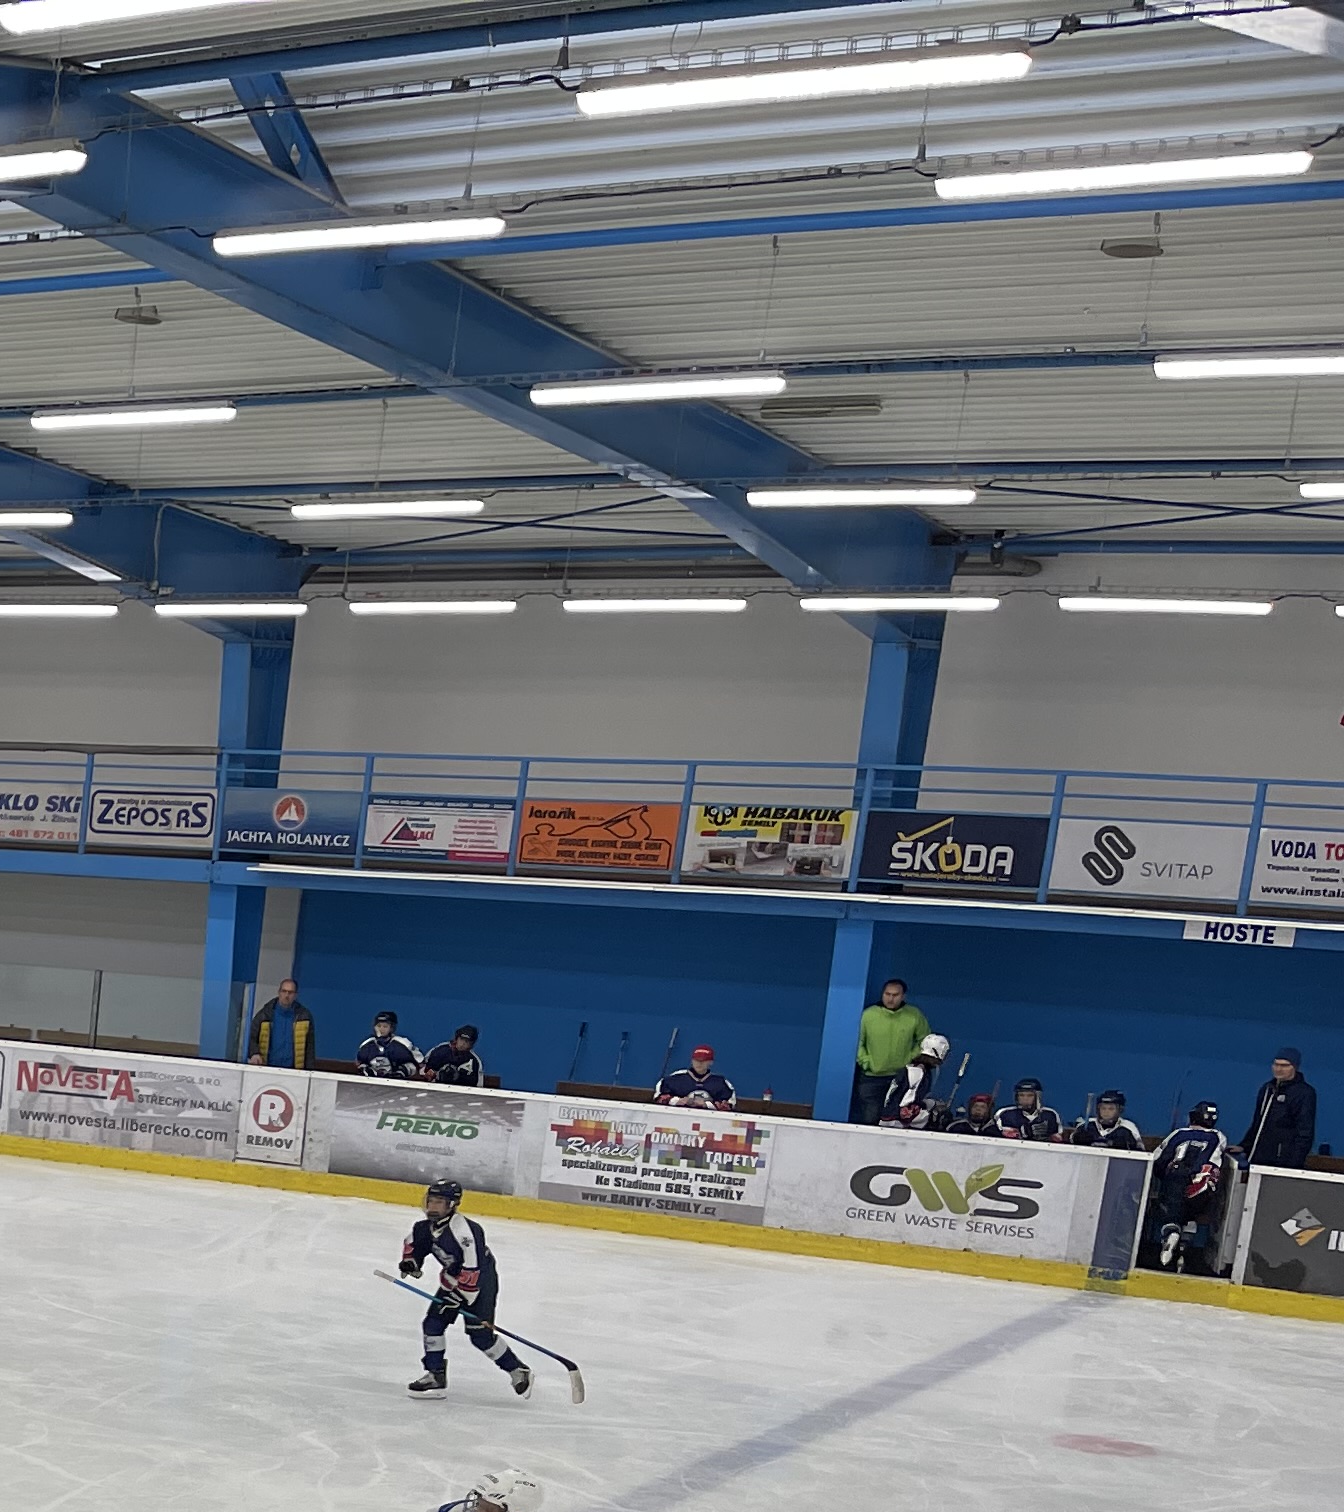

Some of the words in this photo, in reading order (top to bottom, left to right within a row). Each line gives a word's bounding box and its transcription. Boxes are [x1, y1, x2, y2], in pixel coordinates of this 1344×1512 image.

[97, 799, 172, 828] ZEPOS
[743, 807, 847, 822] HABAKUK
[226, 830, 273, 843] JACHTA
[276, 832, 351, 847] HOLANY.CZ
[1271, 839, 1316, 859] VODA
[889, 830, 1014, 874] ŠKODA
[1140, 862, 1213, 880] SVITAP
[16, 1060, 135, 1103] NOVESTA
[138, 1092, 188, 1108] STŘECHY
[190, 1099, 205, 1109] NA
[207, 1100, 234, 1112] KLÍČ
[559, 1106, 608, 1121] BARVY
[19, 1109, 229, 1143] www.novesta.liberecko.com
[376, 1111, 480, 1140] FREMO
[610, 1121, 647, 1135] LAKY
[246, 1134, 295, 1150] REMOV
[565, 1136, 640, 1159] Roháček
[1174, 1140, 1209, 1162] 17
[561, 1158, 638, 1175] specializovaná
[704, 1150, 759, 1168] TAPETY
[595, 1175, 611, 1186] Ke
[613, 1176, 662, 1192] Stadionu
[698, 1186, 745, 1201] SEMILY
[850, 1164, 1044, 1220] GWS
[581, 1191, 716, 1217] www.BARVY-SEMILY.cz
[845, 1207, 897, 1223] GREEN
[904, 1213, 957, 1231] WASTE
[965, 1220, 1035, 1239] SERVISES
